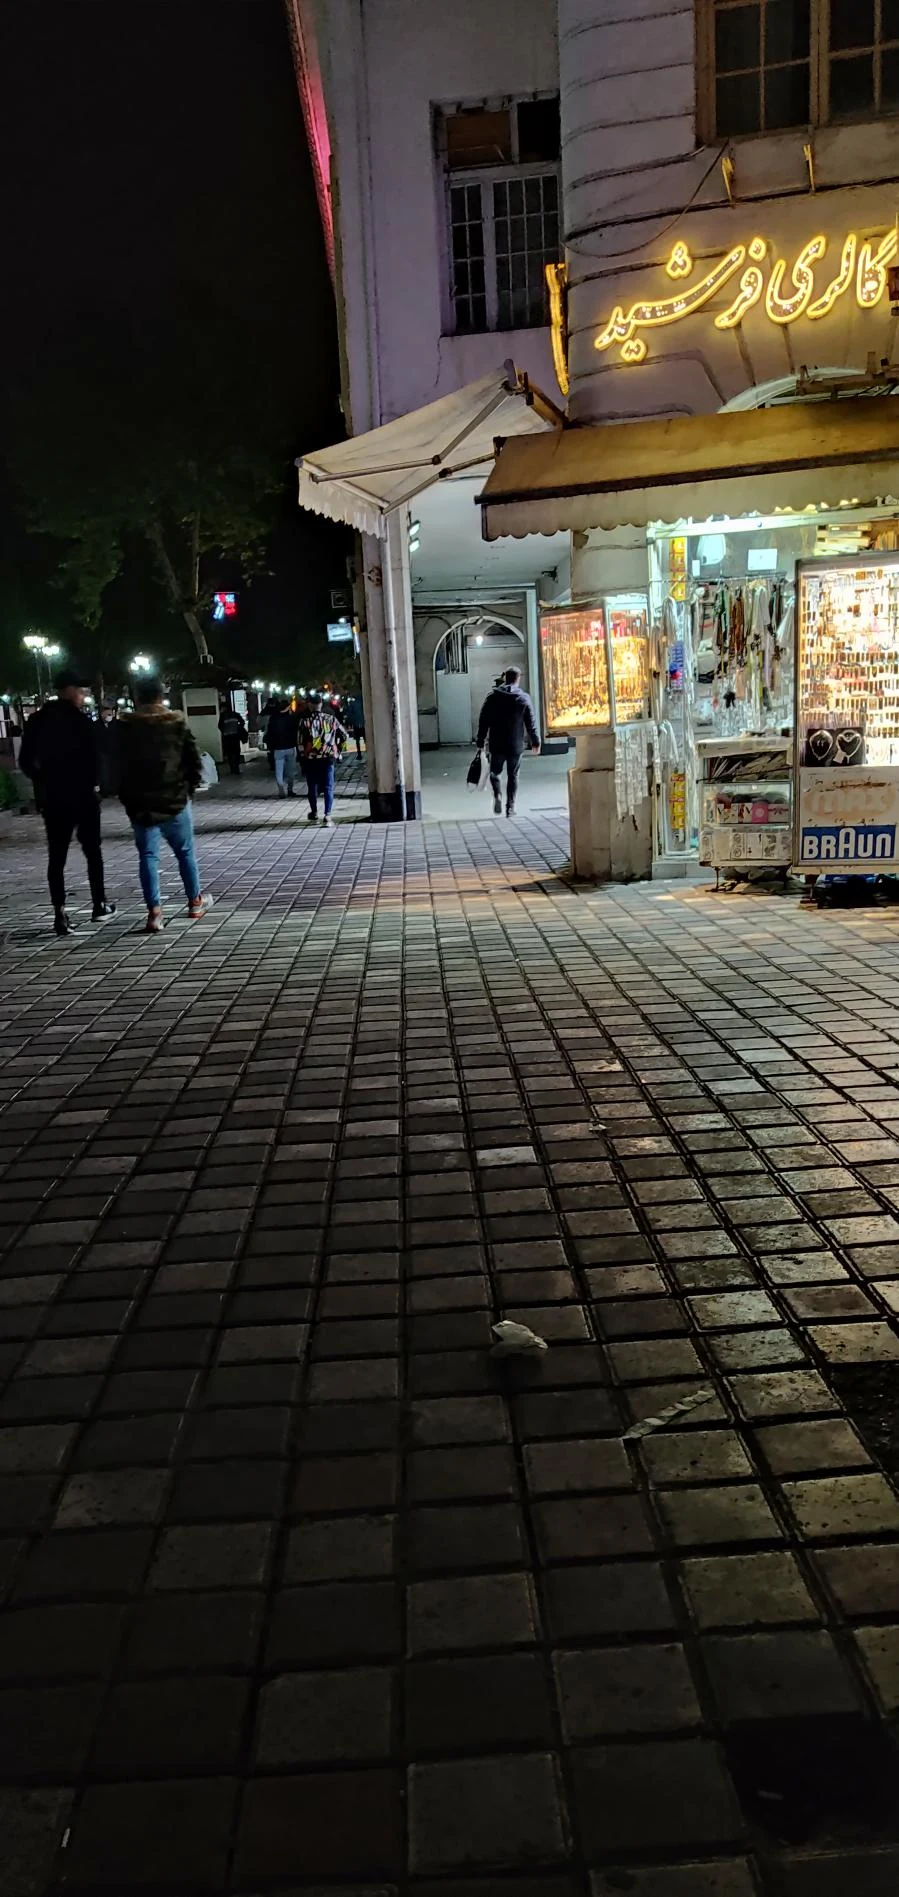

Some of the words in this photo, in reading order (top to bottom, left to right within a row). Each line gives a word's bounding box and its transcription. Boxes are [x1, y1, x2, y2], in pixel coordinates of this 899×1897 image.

[595, 238, 766, 361] فرشید
[767, 230, 898, 323] گالری
[803, 827, 891, 859] BRAUN
